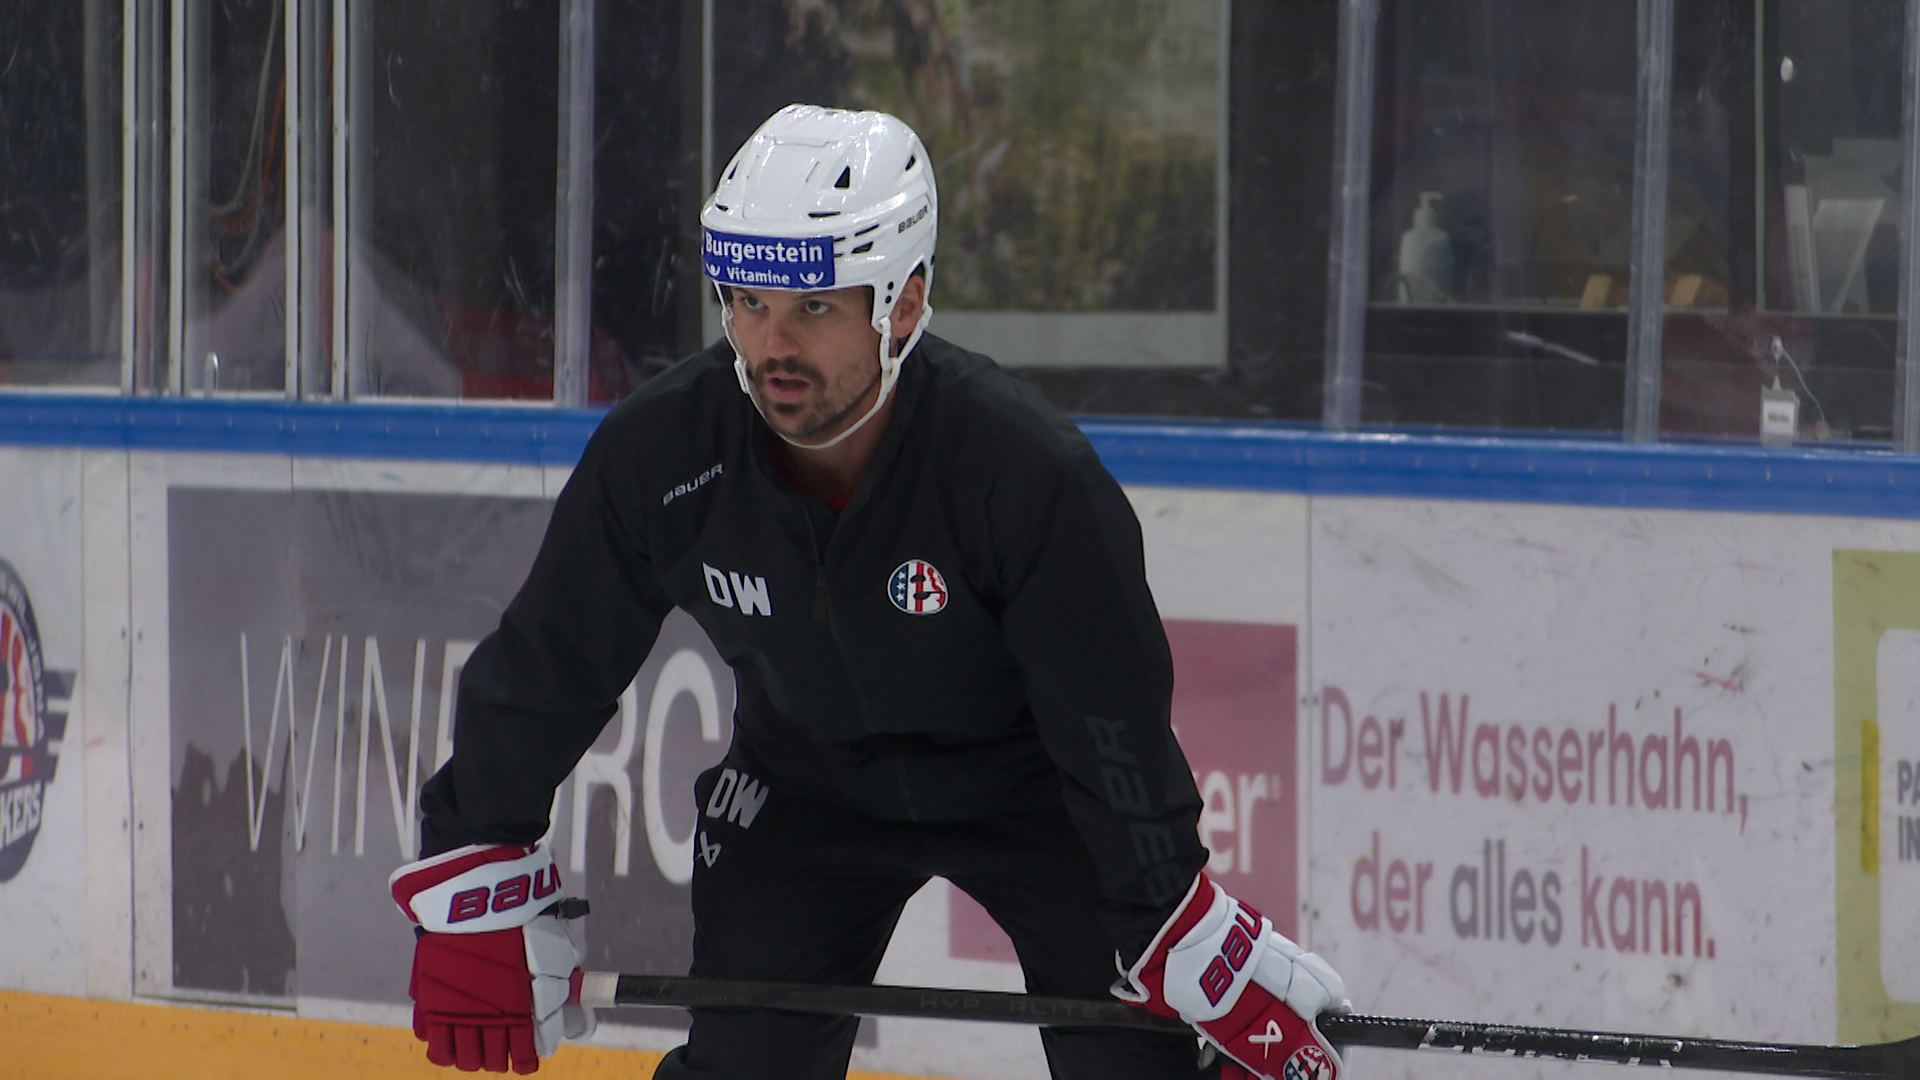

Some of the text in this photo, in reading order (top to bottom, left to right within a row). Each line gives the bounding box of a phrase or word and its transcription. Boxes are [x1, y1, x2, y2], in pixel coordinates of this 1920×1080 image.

[705, 234, 823, 263] Burgerstein
[726, 266, 791, 285] Vitamine
[702, 561, 772, 617] DW
[1321, 685, 1748, 835] Der Wasserhahn,
[706, 768, 770, 829] DW
[1351, 830, 1716, 959] der alles kann.
